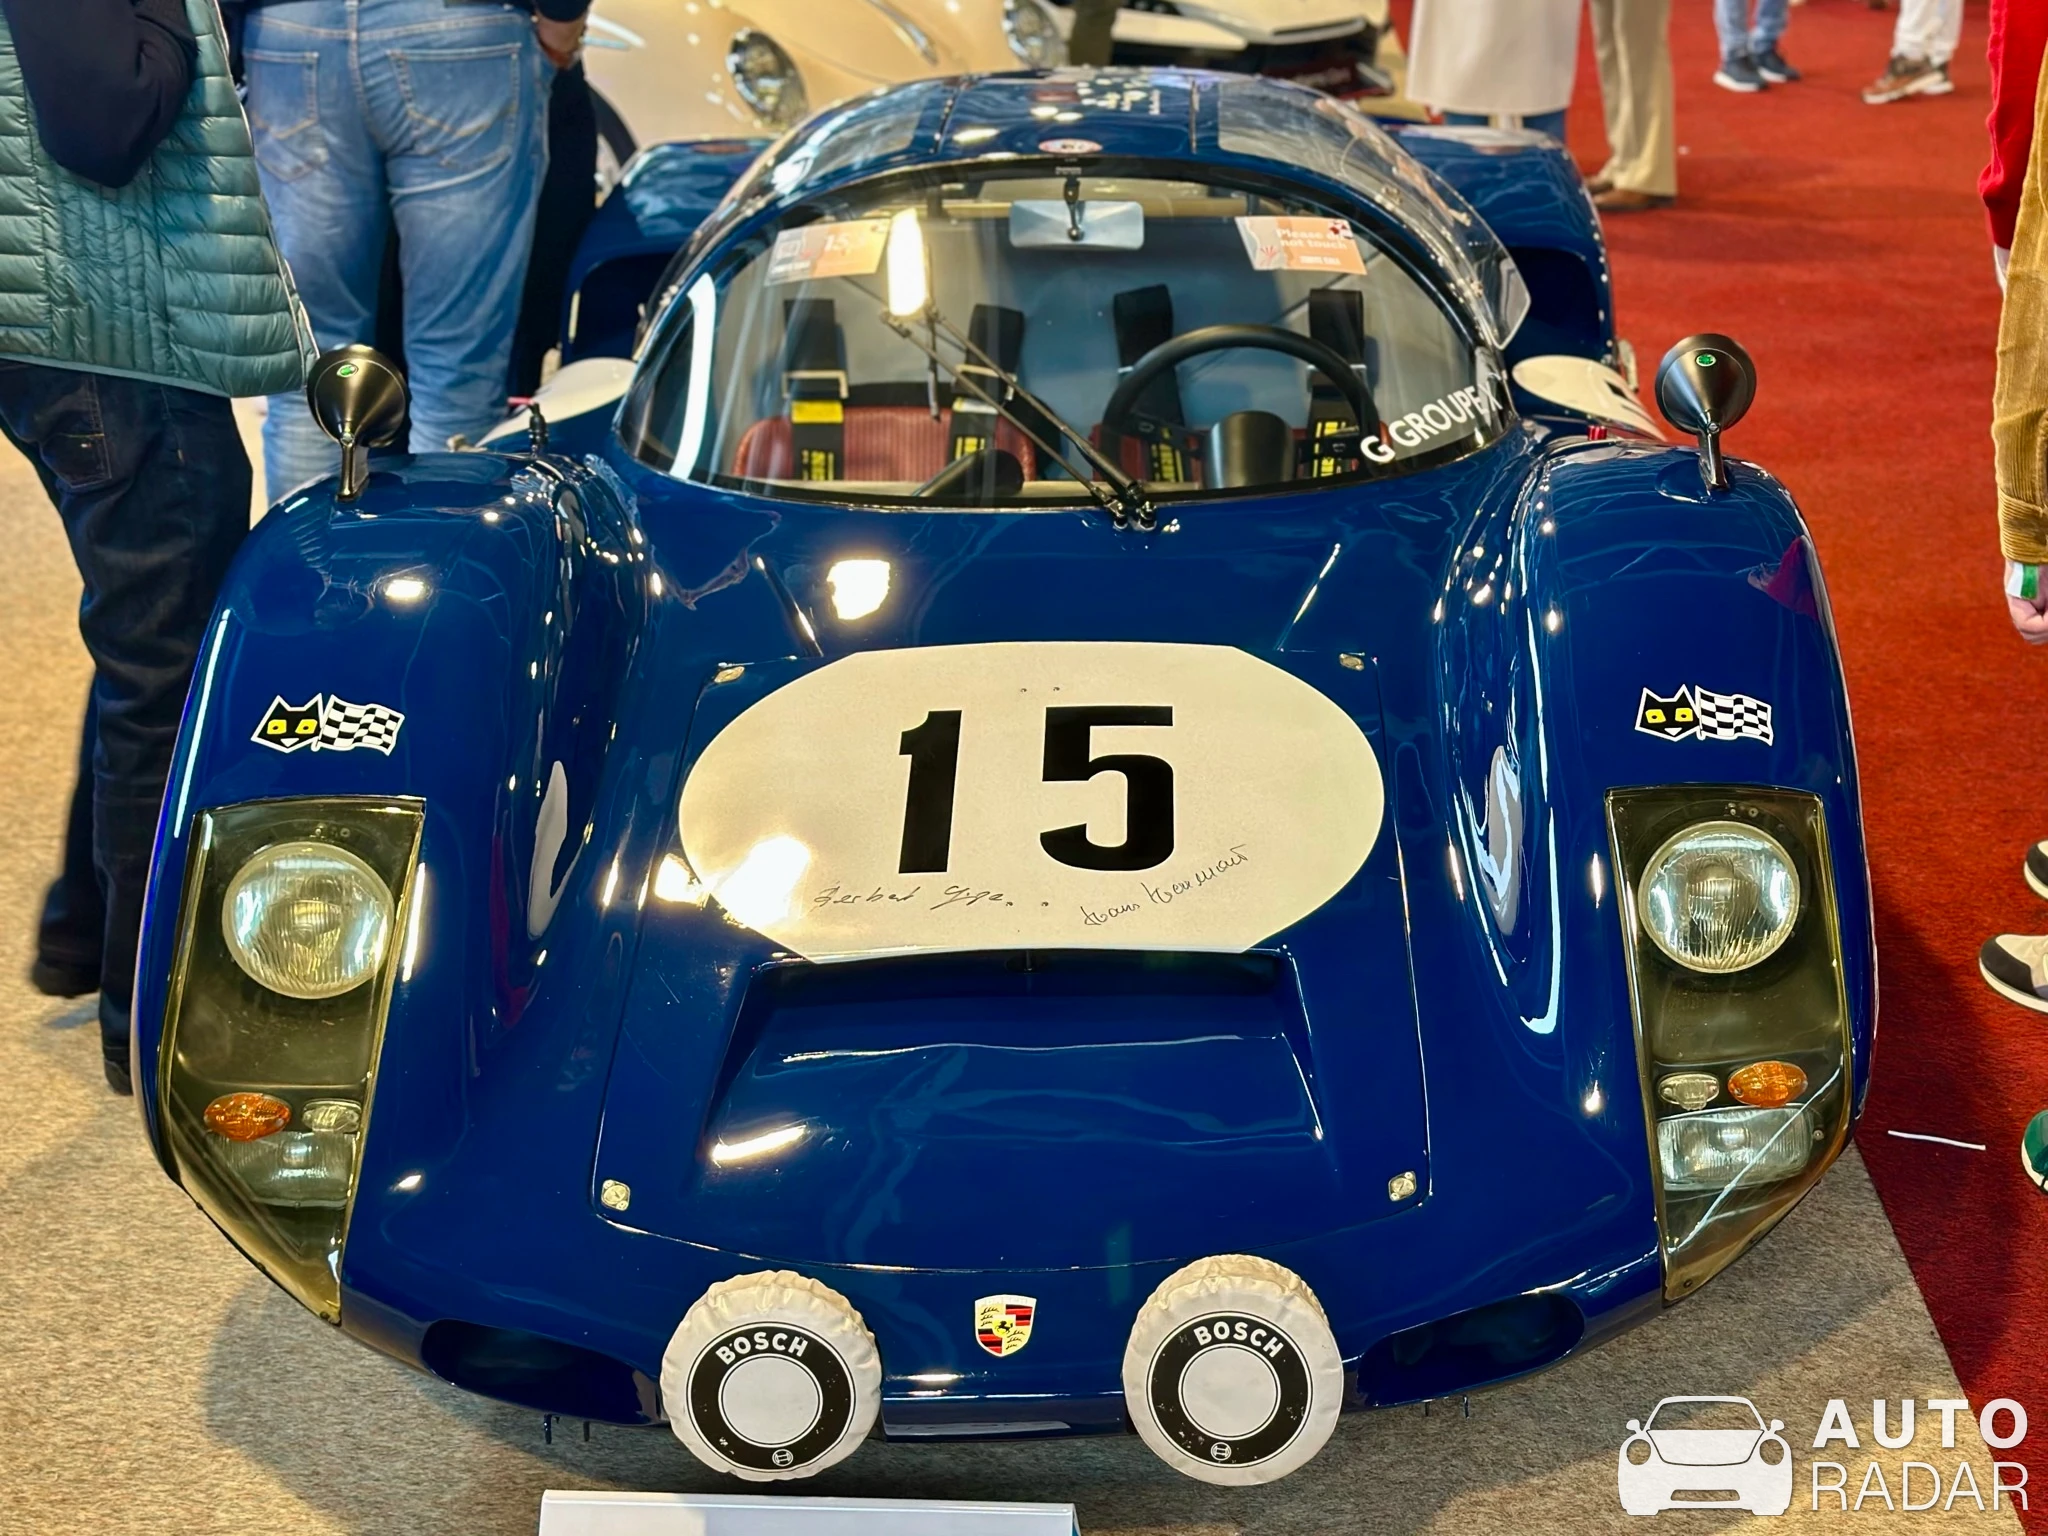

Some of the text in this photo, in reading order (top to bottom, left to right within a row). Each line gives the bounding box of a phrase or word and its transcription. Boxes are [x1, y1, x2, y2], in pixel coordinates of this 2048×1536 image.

[1275, 228, 1325, 240] Please
[1280, 238, 1347, 249] not touch
[1360, 435, 1396, 463] G
[899, 705, 1175, 874] 15
[715, 1331, 809, 1365] BOSCH
[1193, 1321, 1285, 1358] BOSCH
